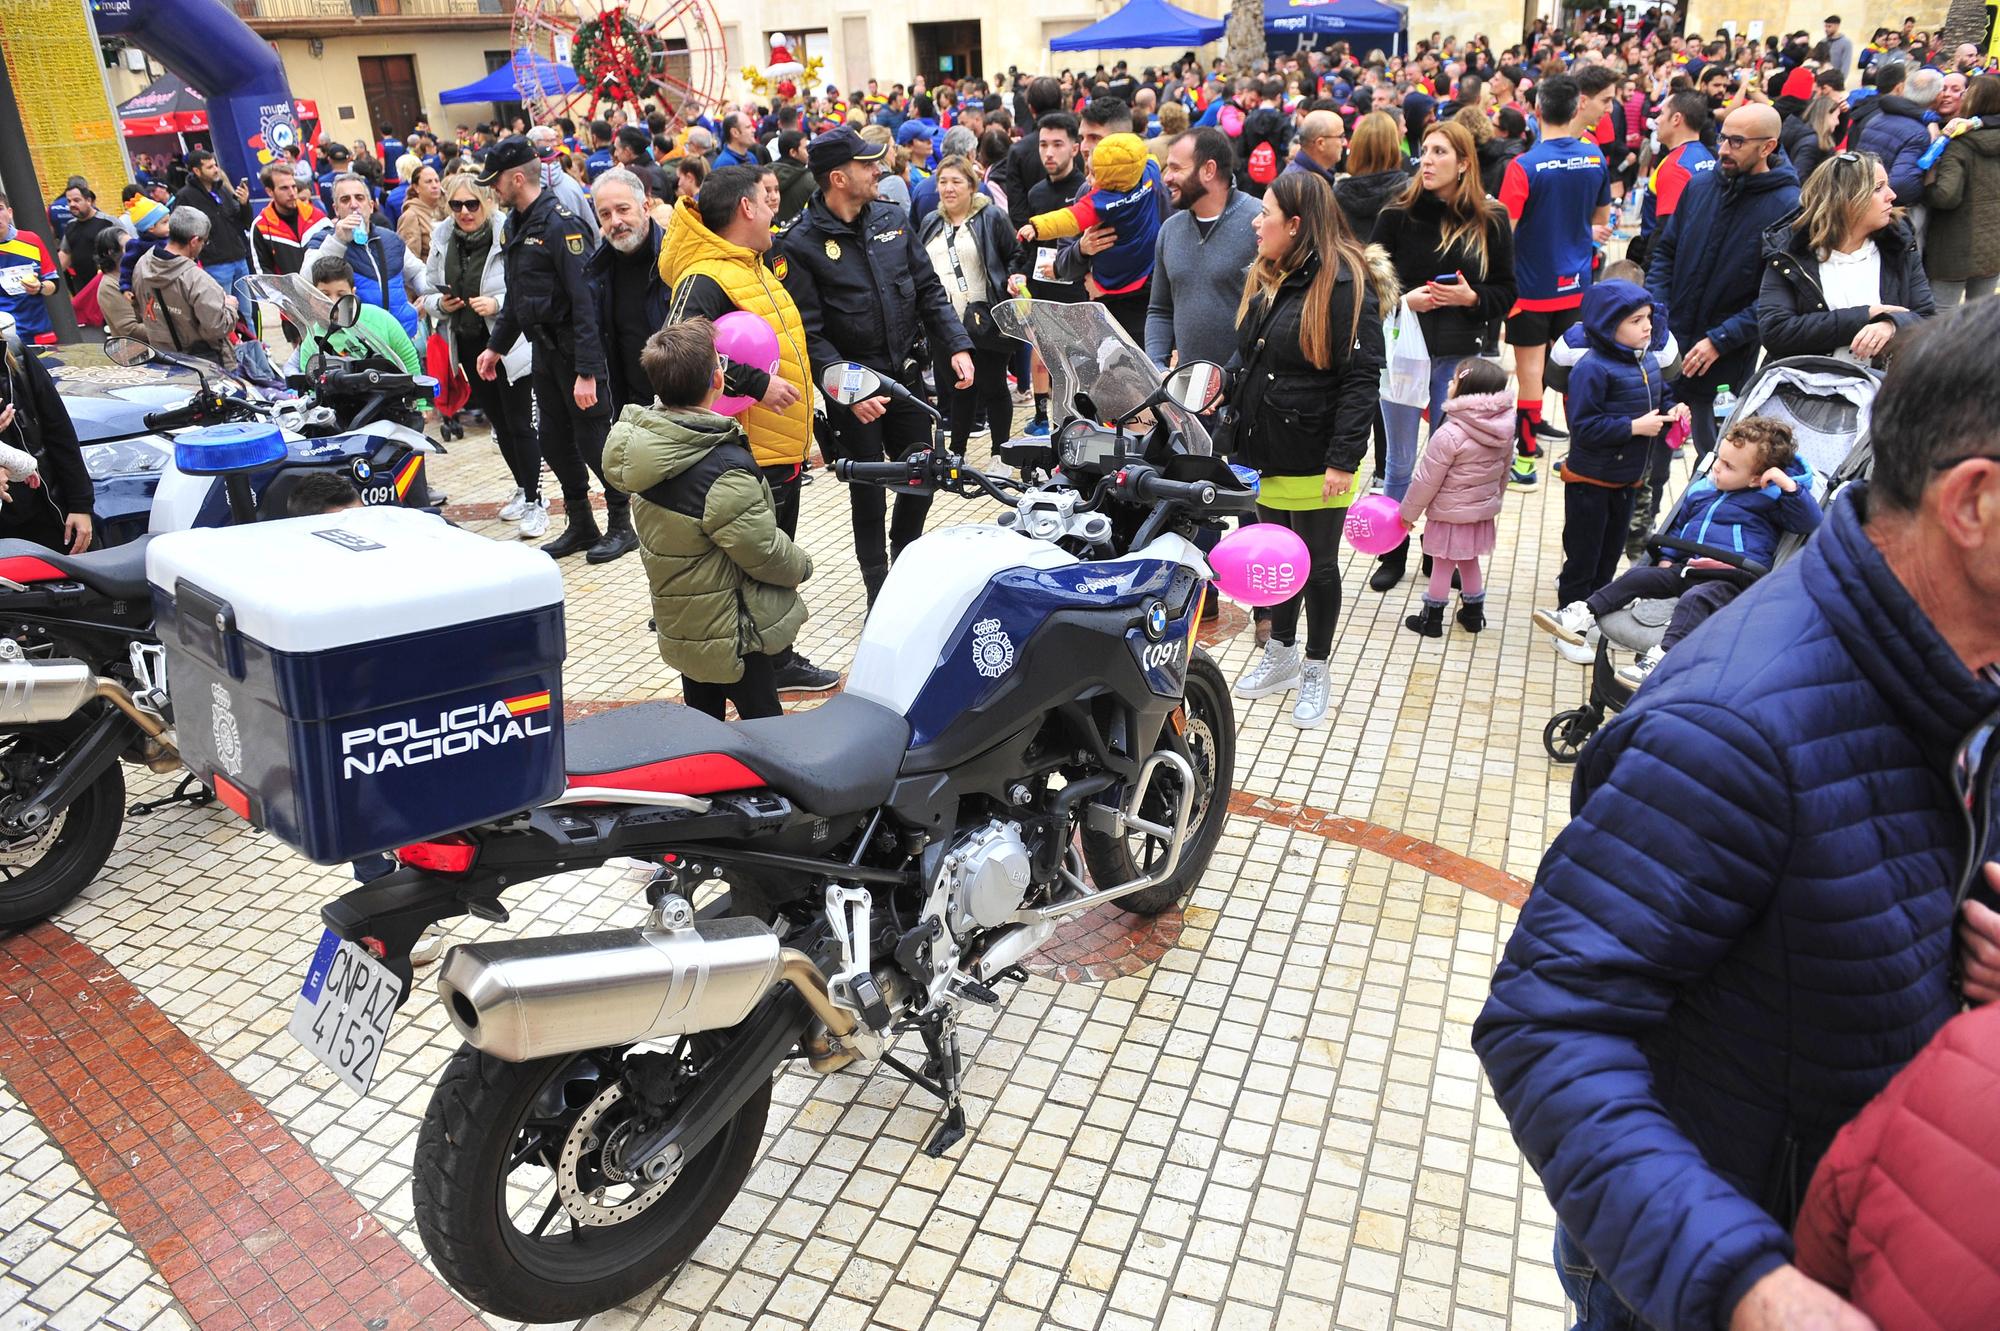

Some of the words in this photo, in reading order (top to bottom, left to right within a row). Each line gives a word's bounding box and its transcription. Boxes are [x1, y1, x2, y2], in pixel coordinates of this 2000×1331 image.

[260, 101, 291, 116] mupol
[369, 485, 395, 503] 091
[1075, 575, 1128, 594] @policia
[1150, 640, 1182, 669] 091
[344, 716, 552, 780] NACIONAL
[310, 970, 321, 988] E
[311, 1000, 376, 1084] 4152
